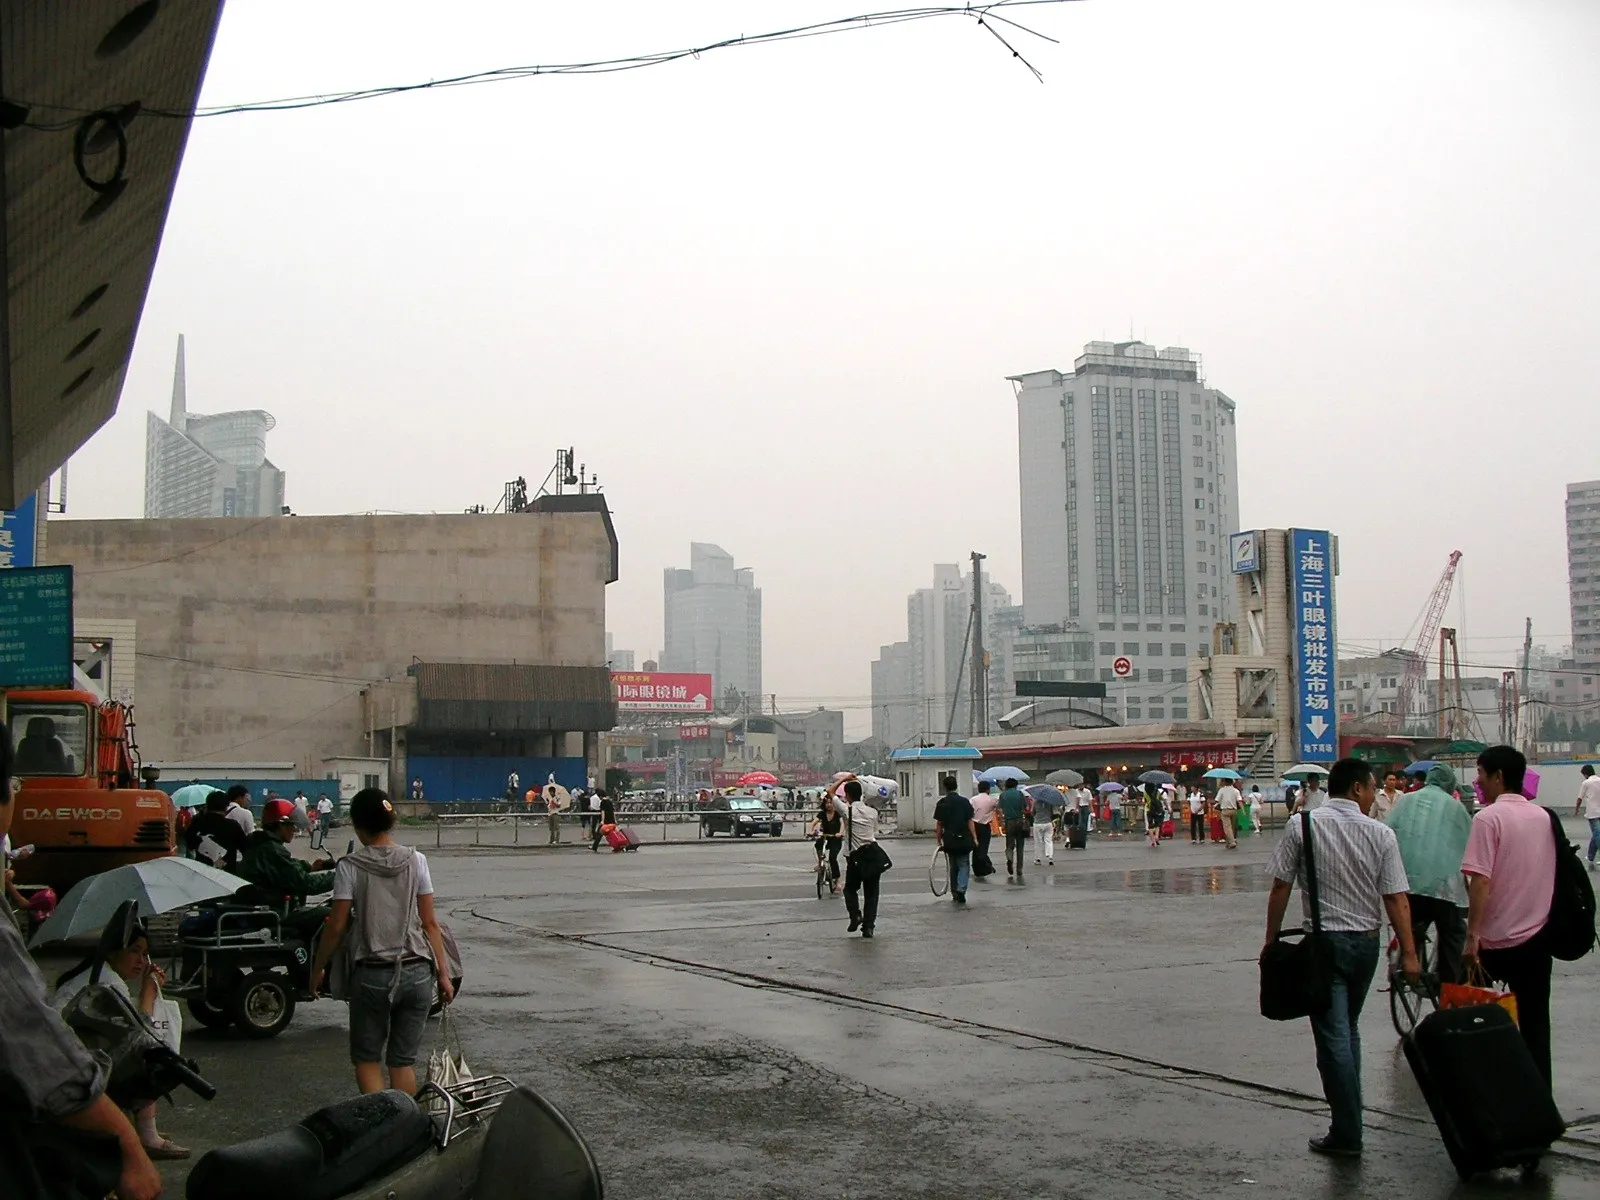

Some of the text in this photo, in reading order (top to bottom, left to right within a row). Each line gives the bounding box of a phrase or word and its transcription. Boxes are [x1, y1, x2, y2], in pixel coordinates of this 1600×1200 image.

[1300, 539, 1328, 710] 上海三叶眼镜批发市场
[617, 684, 687, 699] 际眼镜城
[22, 808, 123, 821] DAEWOO
